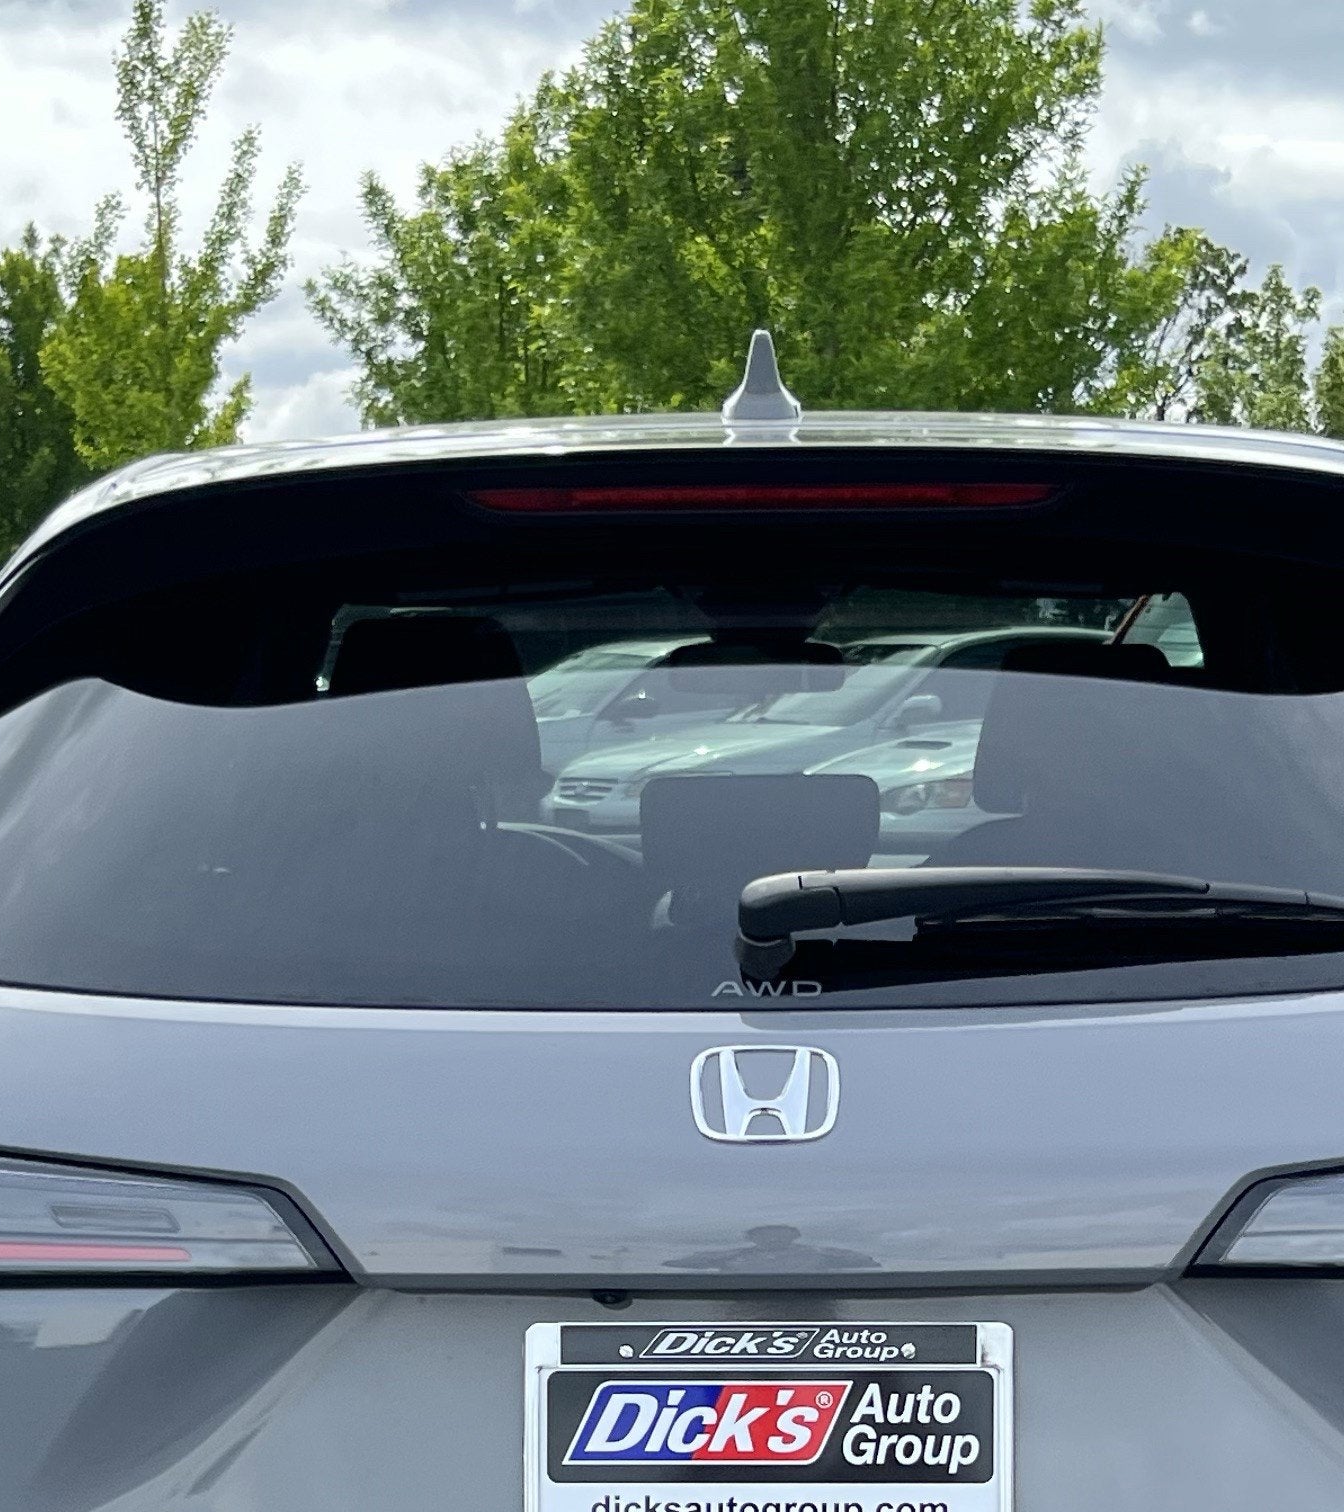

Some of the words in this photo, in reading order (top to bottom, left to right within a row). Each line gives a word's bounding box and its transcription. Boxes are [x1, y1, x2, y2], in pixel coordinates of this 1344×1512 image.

[711, 980, 822, 997] AWD
[653, 1331, 800, 1355] Dick's
[820, 1329, 888, 1344] Auto
[813, 1343, 902, 1361] Group
[849, 1383, 961, 1424] Auto
[842, 1424, 980, 1474] Group
